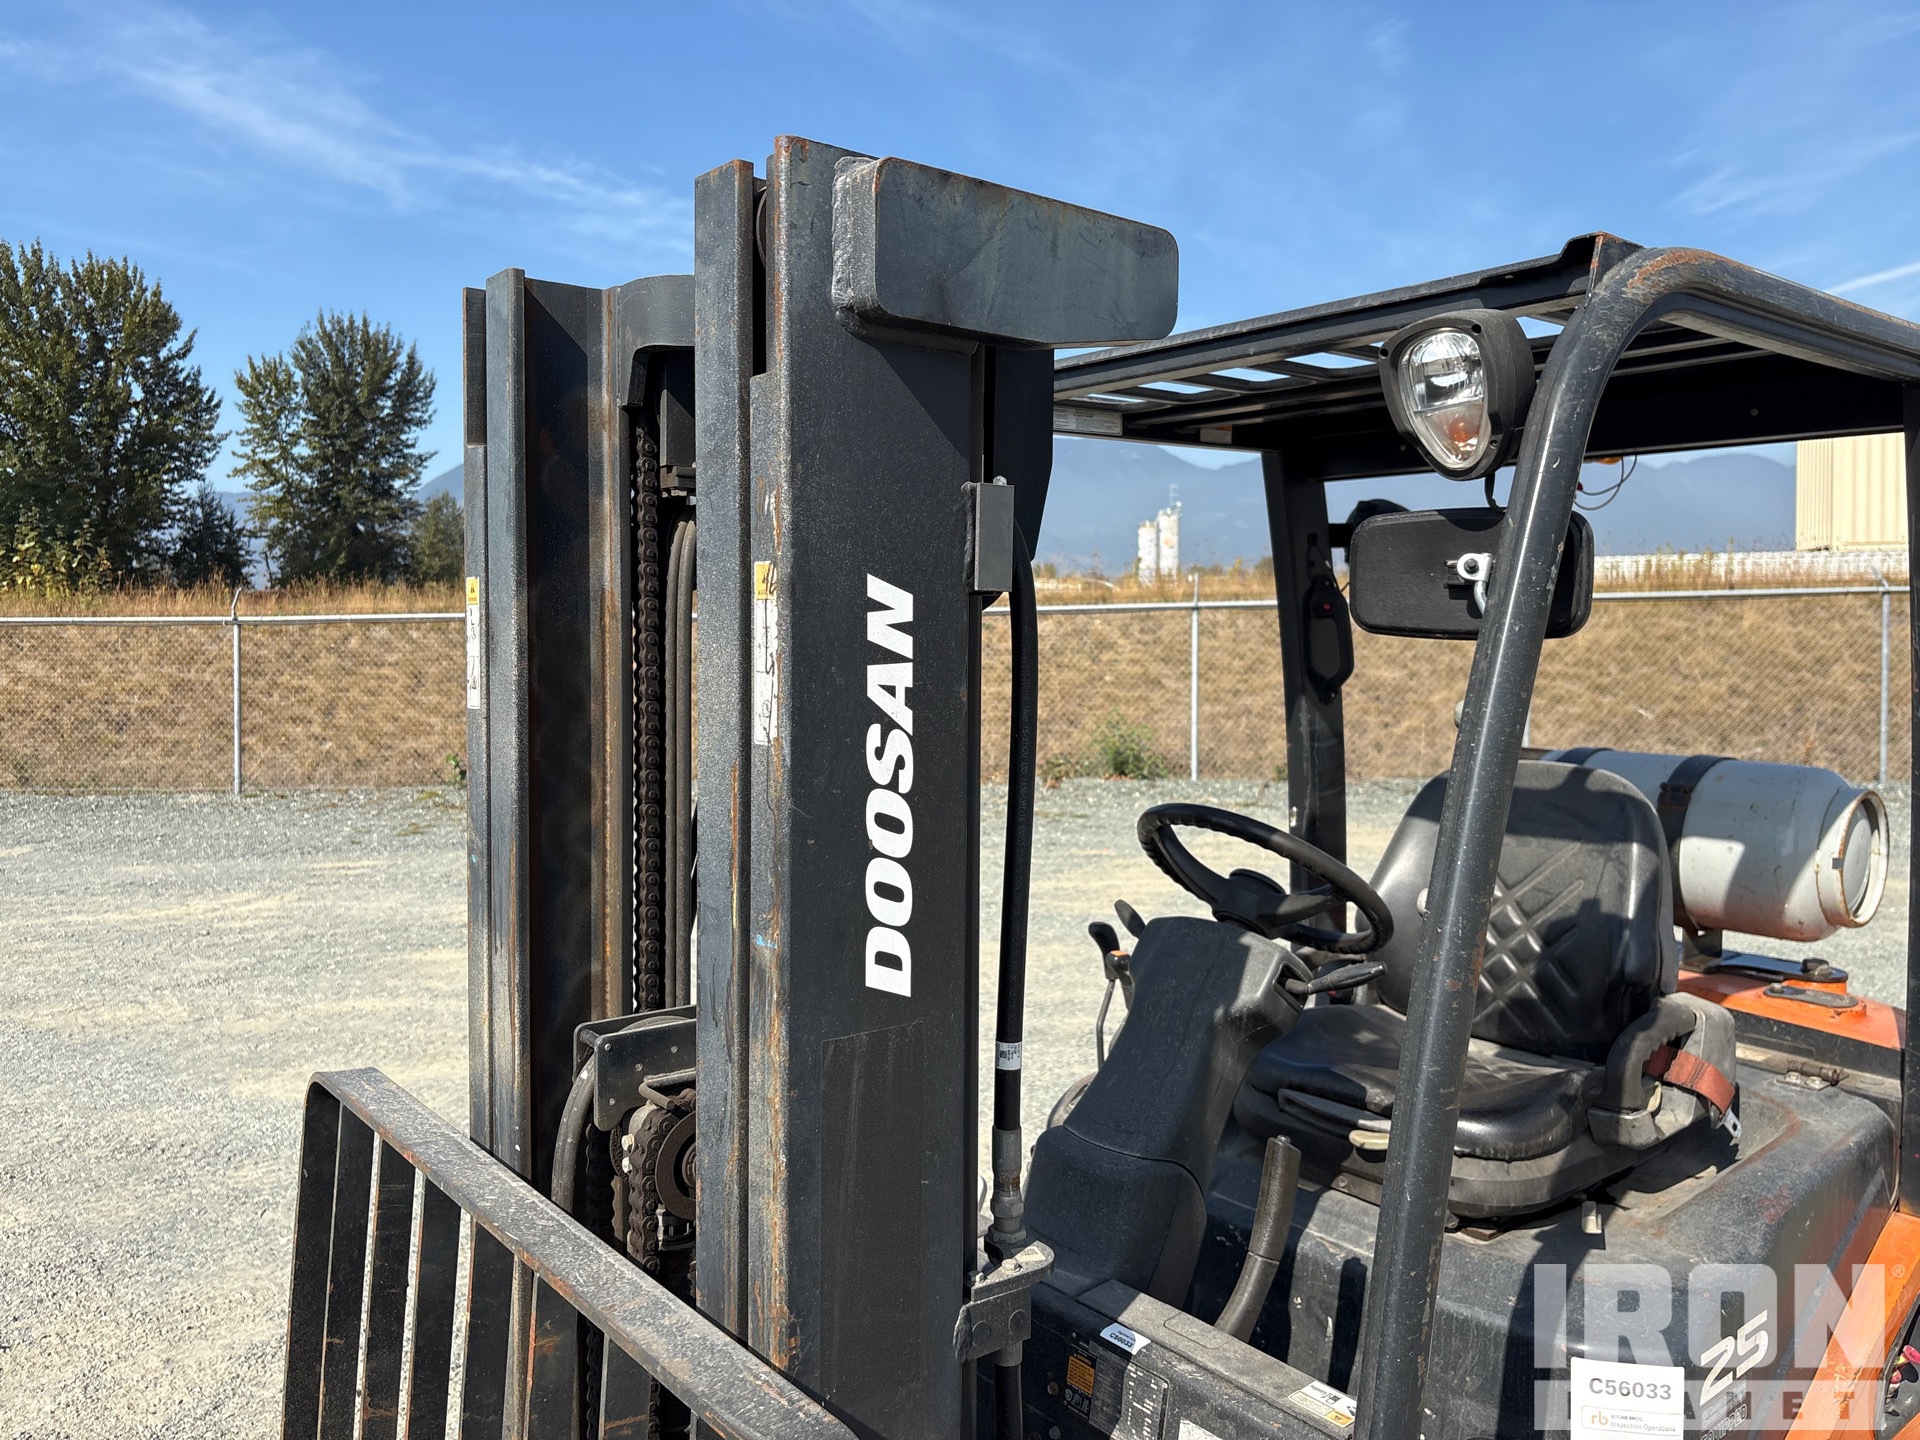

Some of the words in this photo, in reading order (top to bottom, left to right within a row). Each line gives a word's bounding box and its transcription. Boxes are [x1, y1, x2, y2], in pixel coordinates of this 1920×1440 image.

[865, 572, 914, 998] DOOSAN
[1109, 1332, 1134, 1348] C56033
[1700, 1309, 1769, 1407] 25
[1588, 1377, 1672, 1401] C56033
[1610, 1421, 1643, 1430] Inspection
[1643, 1423, 1676, 1433] Operations
